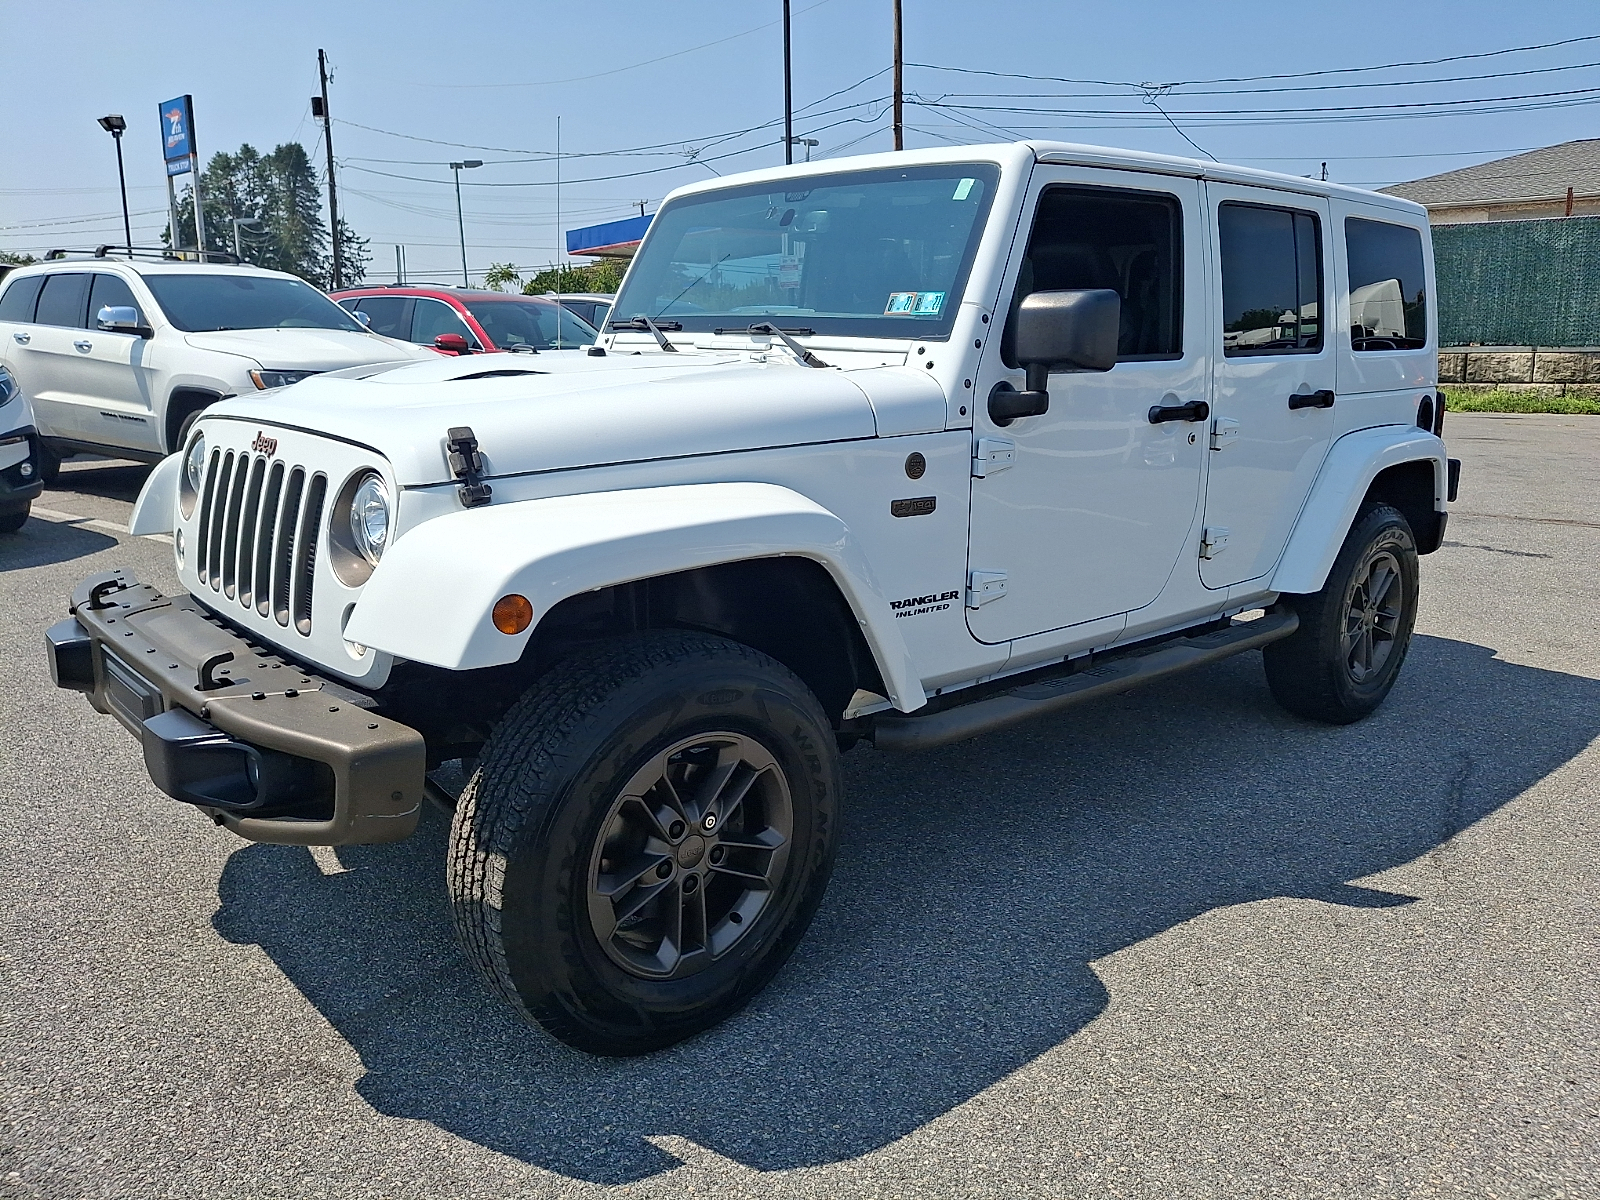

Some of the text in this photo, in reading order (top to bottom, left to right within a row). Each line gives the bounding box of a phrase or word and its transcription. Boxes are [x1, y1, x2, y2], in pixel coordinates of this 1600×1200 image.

[171, 115, 182, 135] 7th
[251, 430, 278, 460] Jeep
[913, 500, 935, 510] 1941
[890, 591, 959, 609] RANGLER
